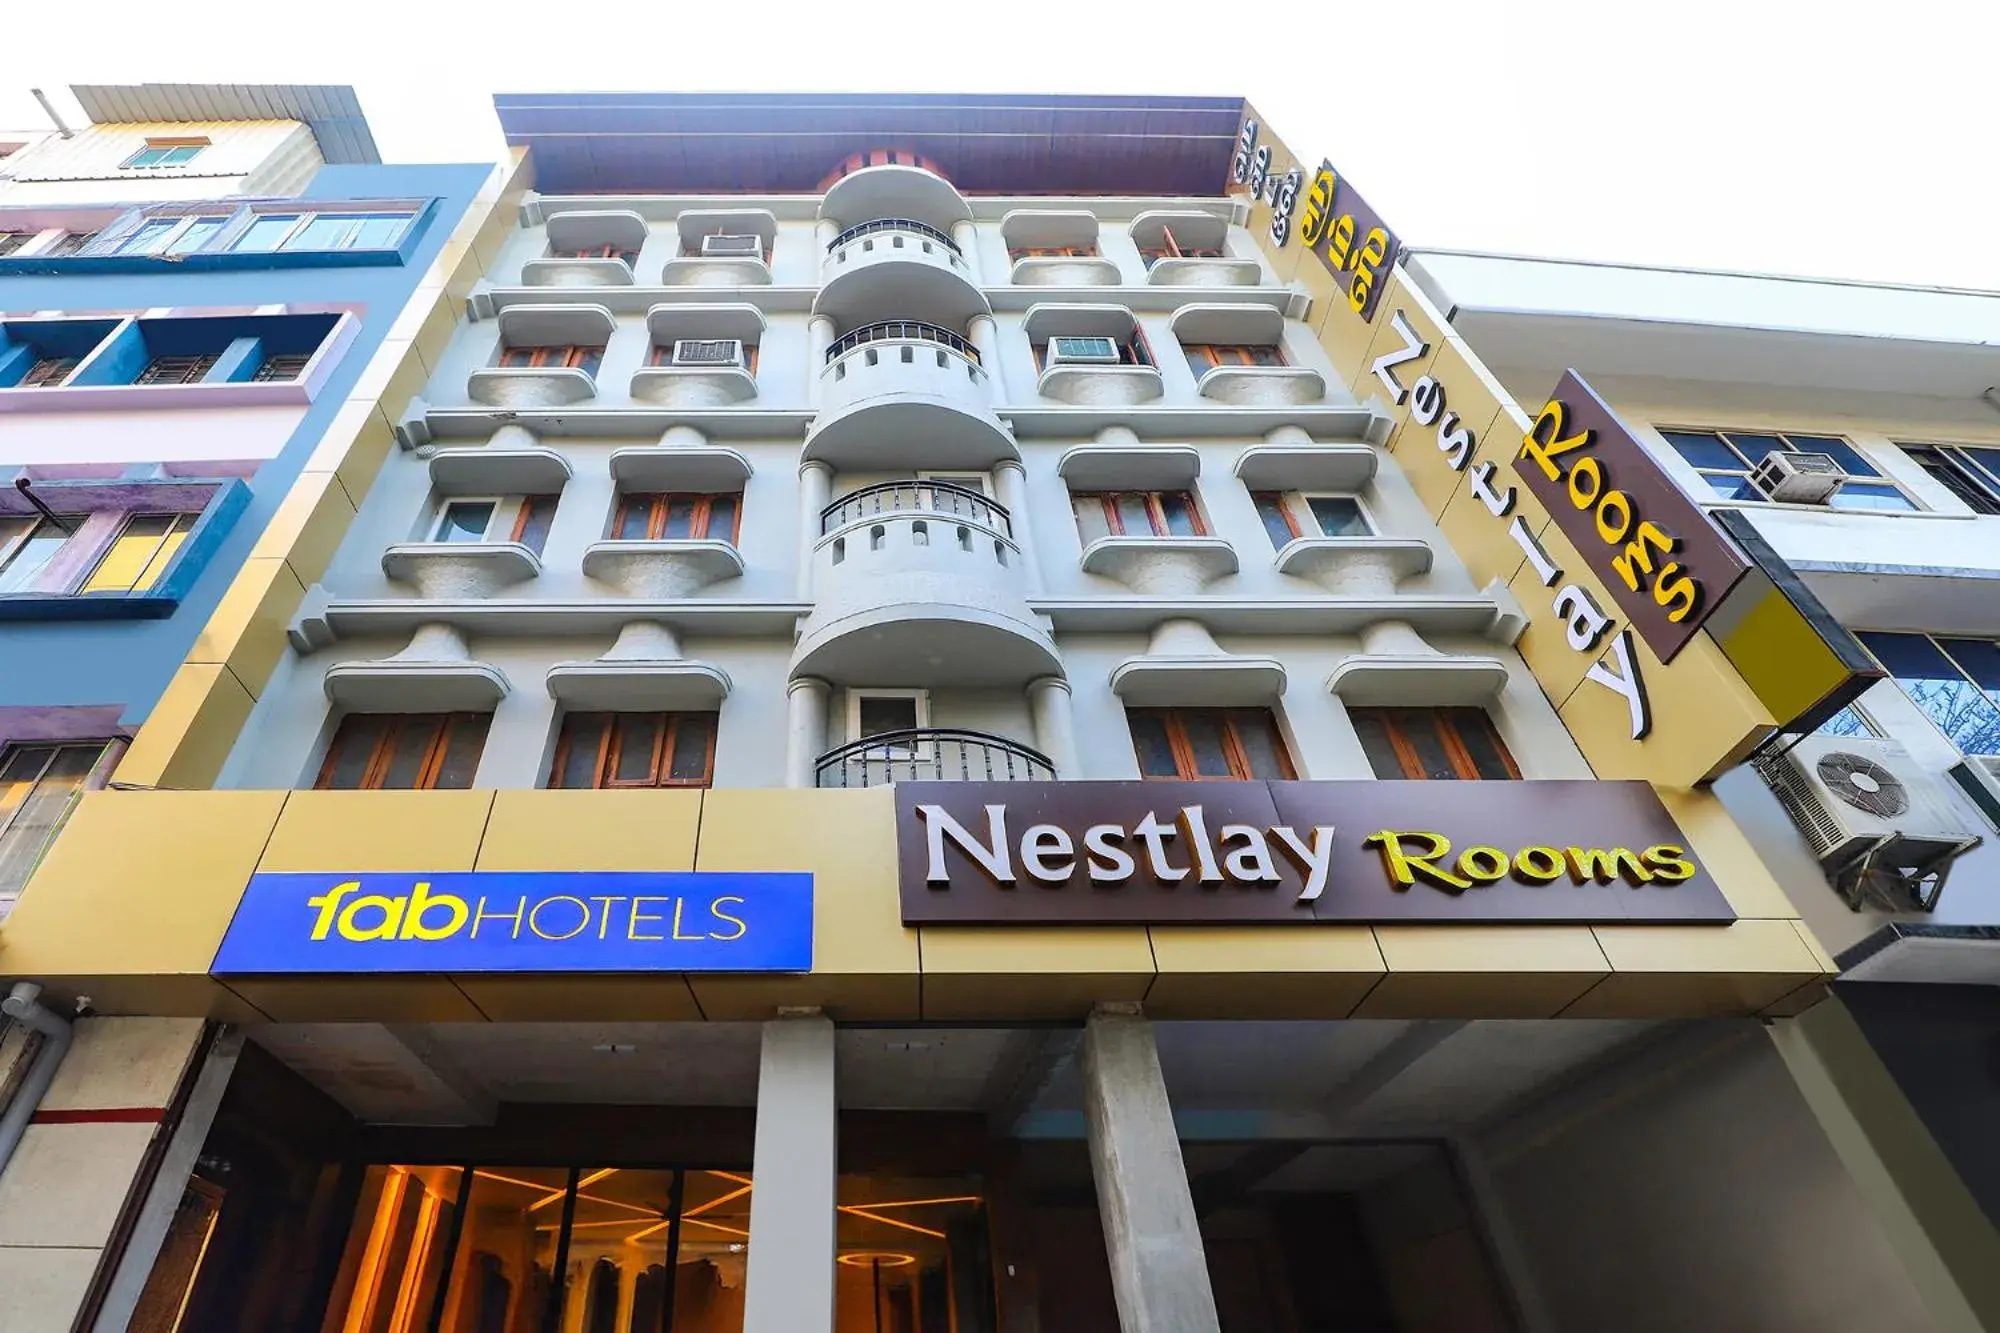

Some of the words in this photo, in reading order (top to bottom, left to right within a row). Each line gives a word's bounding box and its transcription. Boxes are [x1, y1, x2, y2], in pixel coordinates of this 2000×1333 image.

[1301, 169, 1390, 314] ரூம்ஸ்
[1520, 399, 1702, 624] Rooms
[915, 803, 1336, 903] Nestlay
[1365, 829, 1697, 893] Rooms
